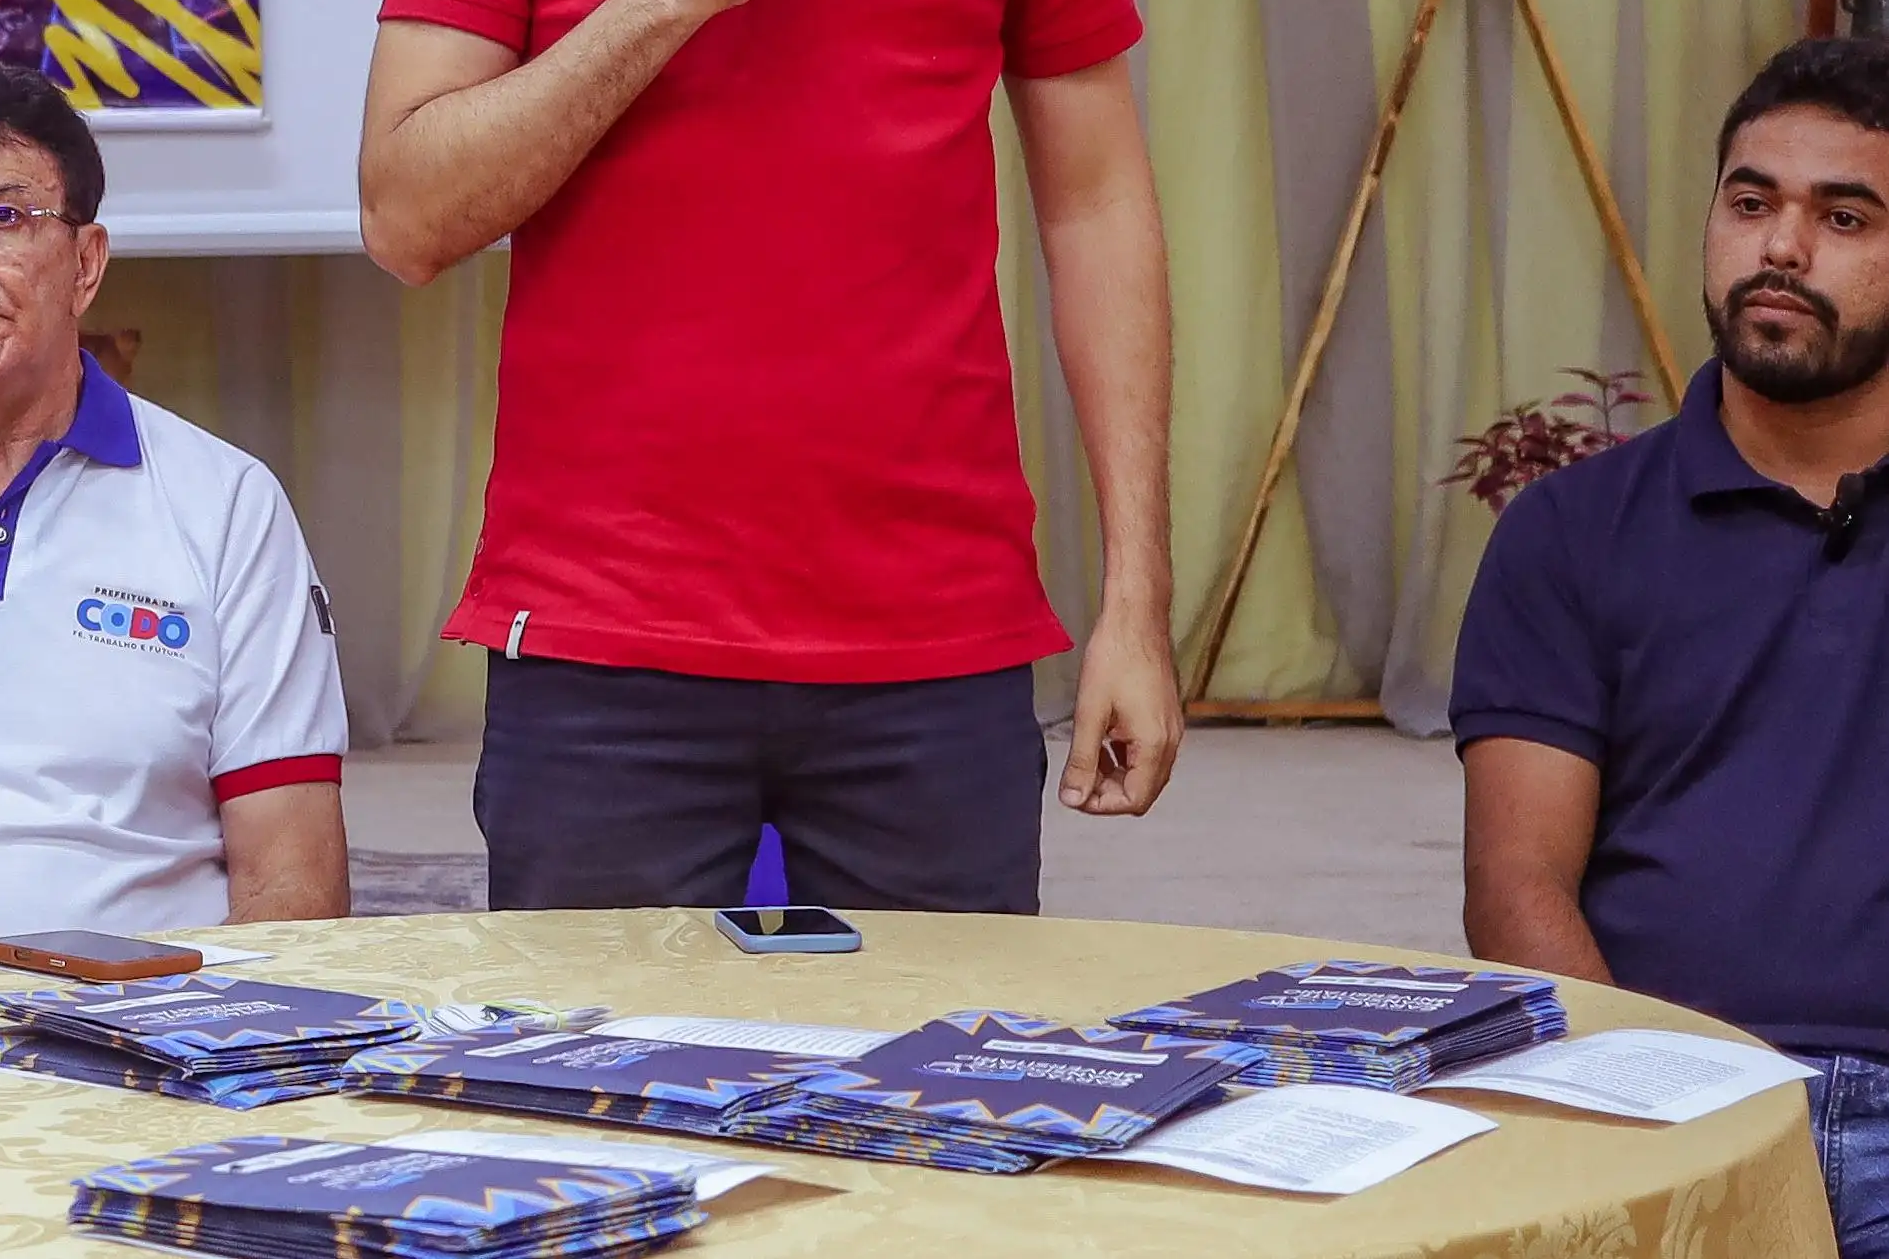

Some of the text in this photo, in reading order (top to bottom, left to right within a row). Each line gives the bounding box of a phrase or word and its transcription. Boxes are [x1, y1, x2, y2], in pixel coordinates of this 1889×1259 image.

[94, 586, 159, 606] PREFEITURA
[89, 634, 138, 651] TRABALHO
[149, 645, 187, 660] FUTURO
